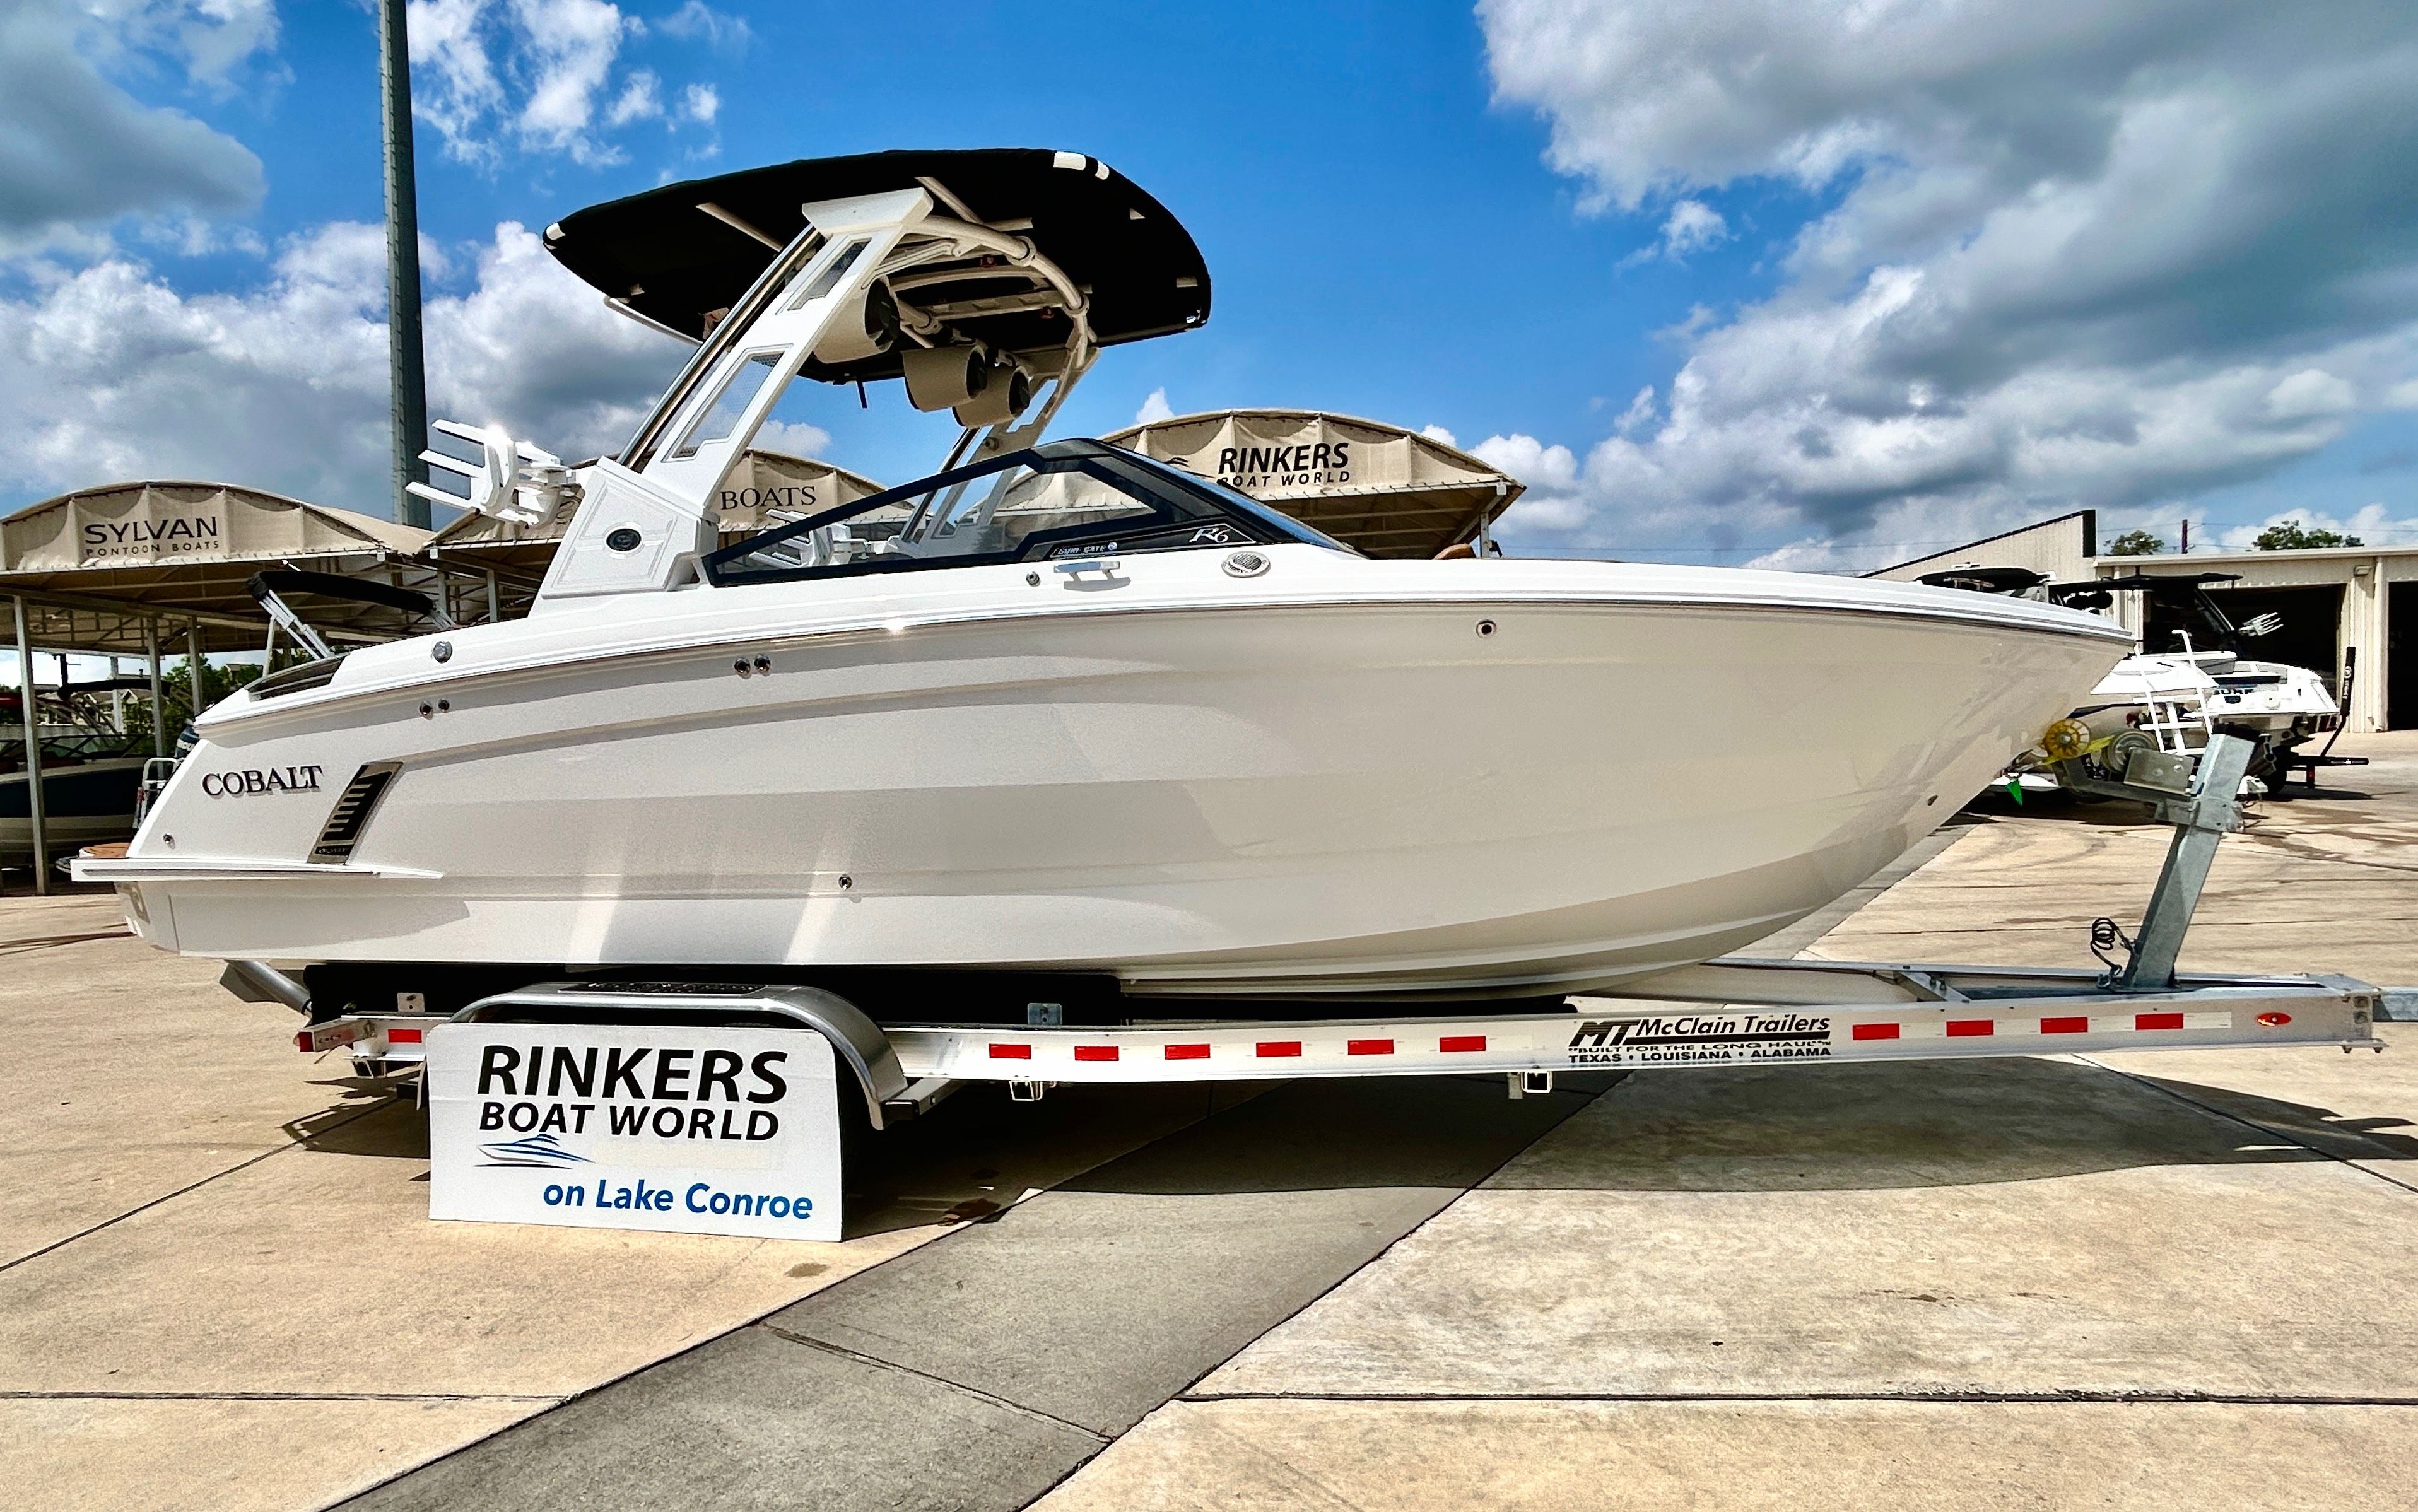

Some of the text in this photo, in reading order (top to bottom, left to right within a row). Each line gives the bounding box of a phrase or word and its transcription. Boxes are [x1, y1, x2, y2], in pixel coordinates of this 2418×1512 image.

[1218, 442, 1349, 474] RINKERS
[1281, 471, 1350, 486] WORLD
[720, 486, 816, 510] BOATS
[84, 516, 218, 544] SYLVAN
[86, 541, 219, 556] PONTOON BOATS
[202, 765, 323, 796] COBALT
[1635, 1017, 1736, 1036] McClain
[1744, 1014, 1831, 1033] Trailers
[1568, 1047, 1831, 1063] TEXAS LOUISIANA ALABAMA
[477, 1045, 789, 1105] RINKERS
[479, 1101, 780, 1141] BOAT WORLD
[543, 1179, 813, 1220] on Lake Conroe
